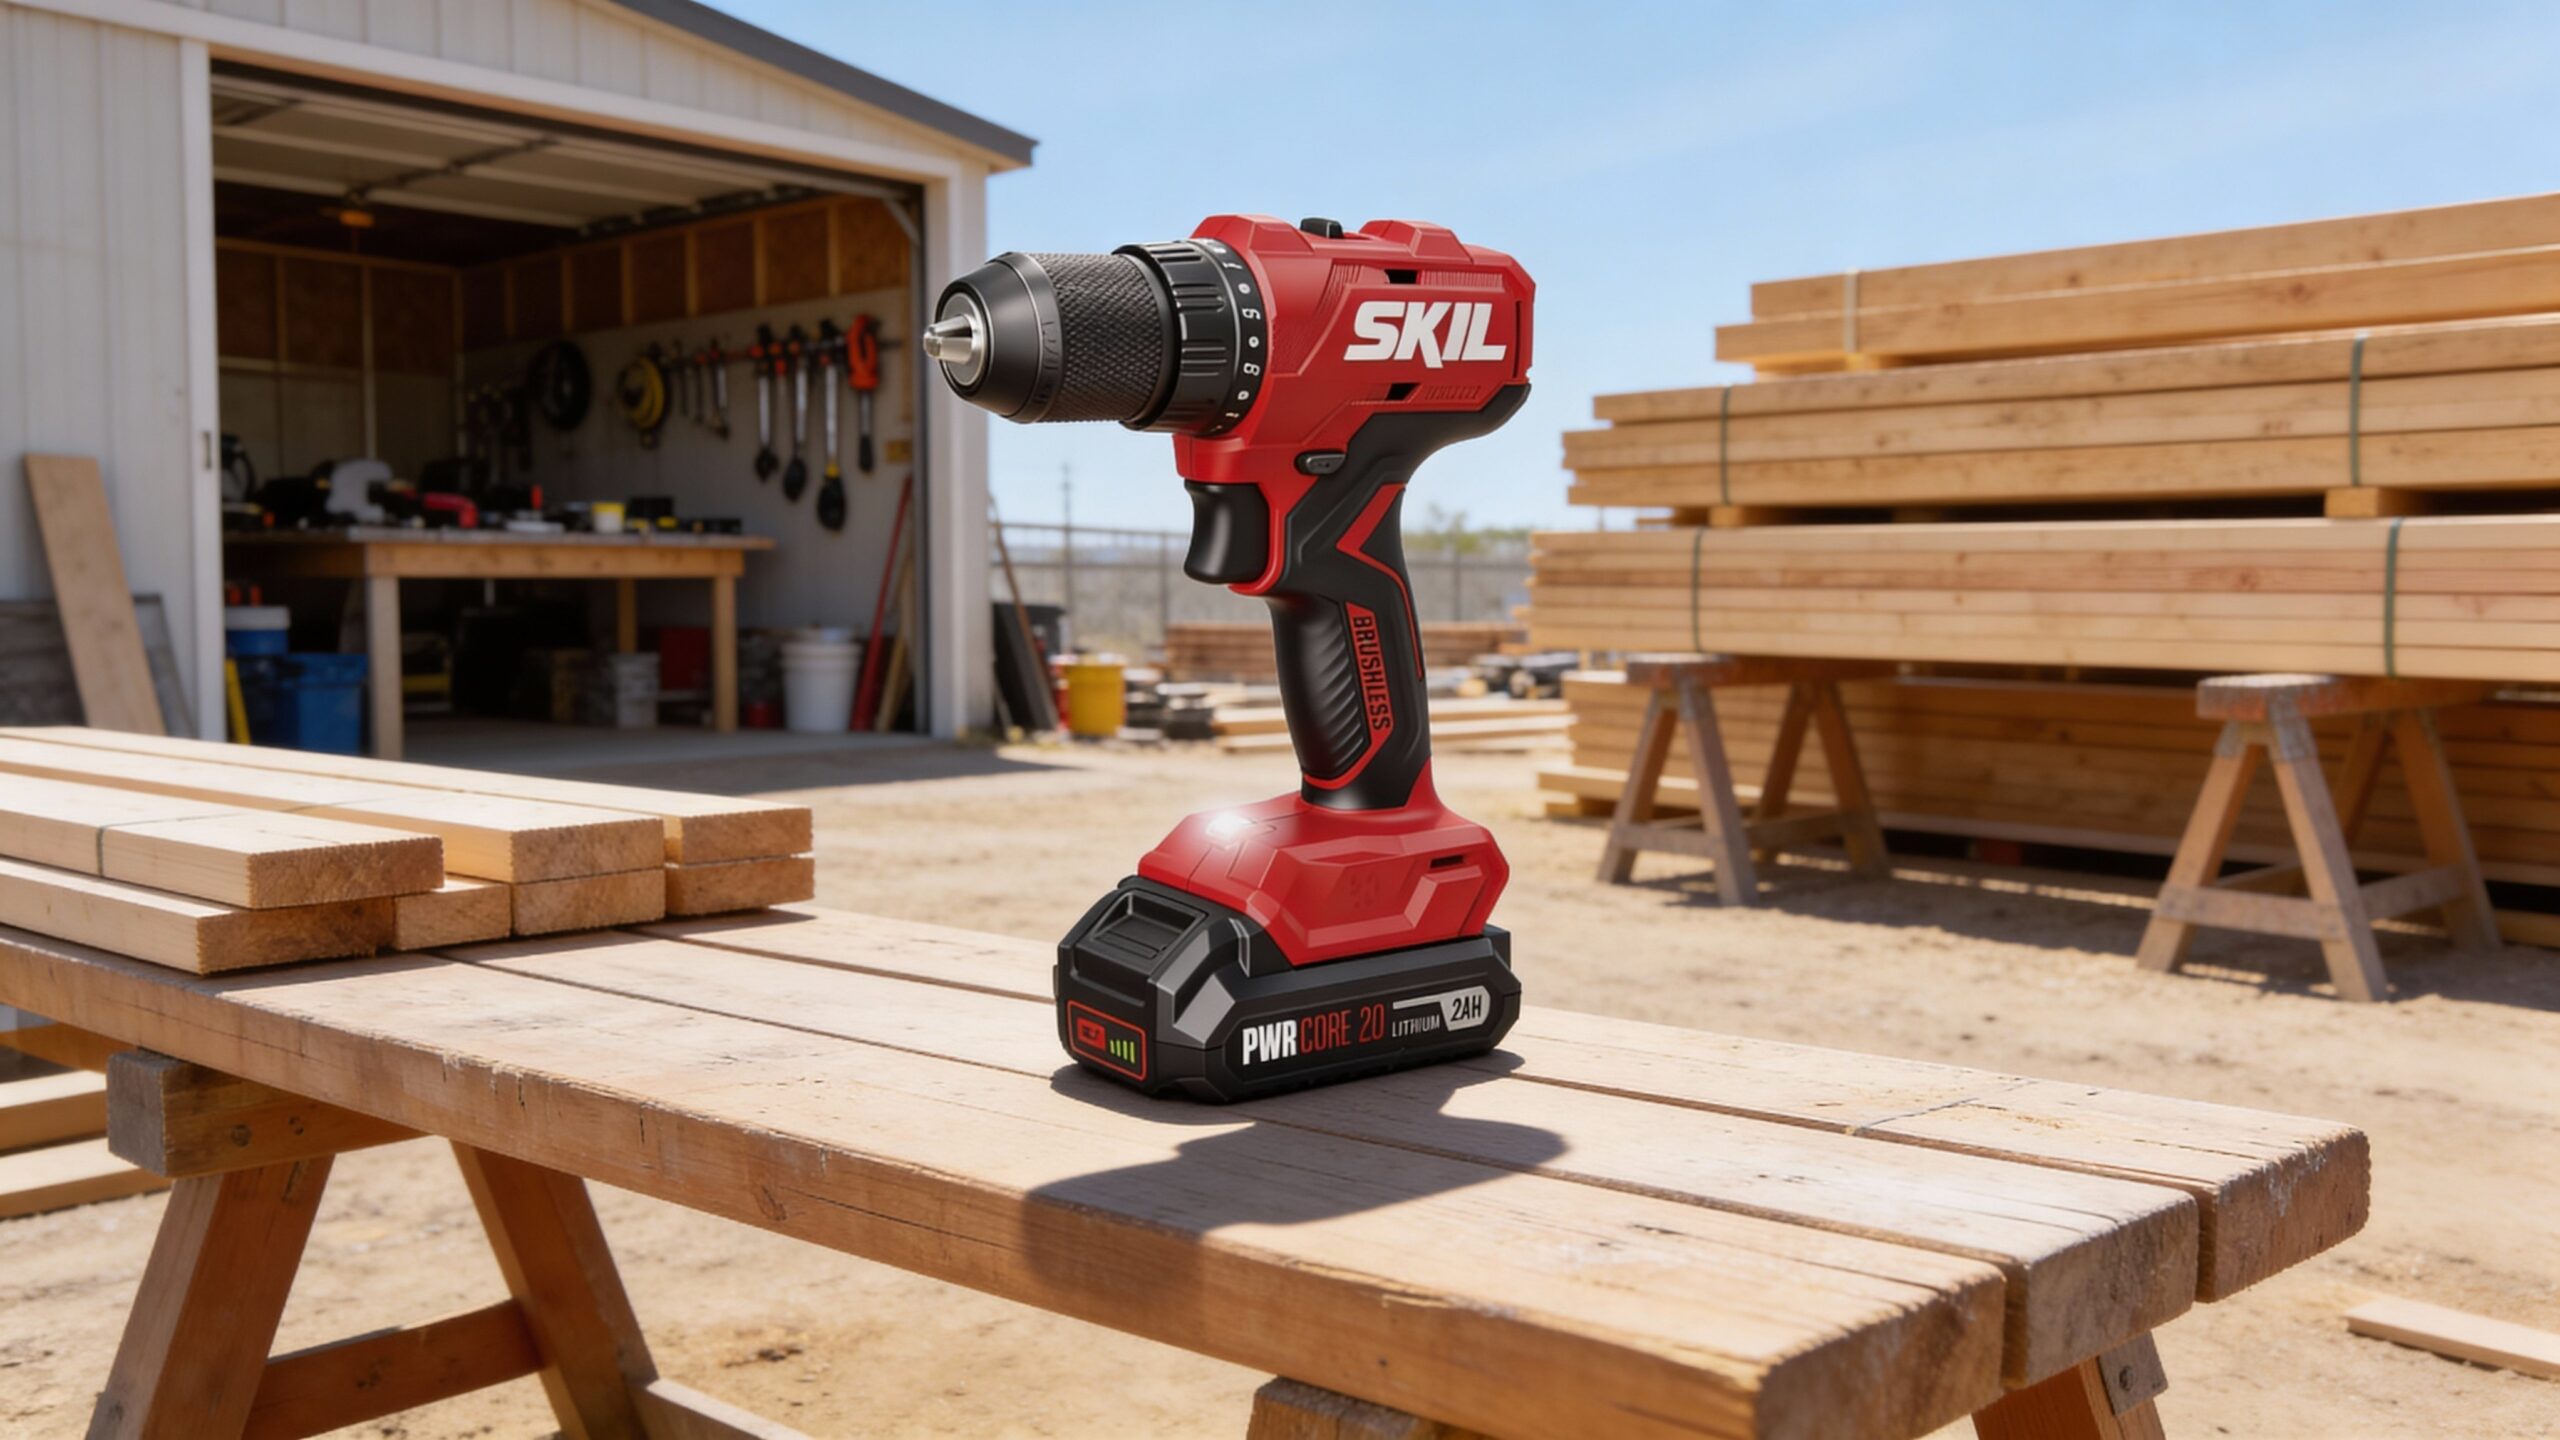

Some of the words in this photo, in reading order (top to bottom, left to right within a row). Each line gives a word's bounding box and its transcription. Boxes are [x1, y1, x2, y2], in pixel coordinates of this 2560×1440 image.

[1343, 301, 1507, 368] SKIL
[1353, 615, 1390, 731] BRUSHLESS
[1242, 1019, 1297, 1066] PWR
[1300, 1009, 1352, 1054] CORE
[1359, 1003, 1386, 1043] 20
[1391, 1015, 1441, 1038] LITHIUM
[1450, 994, 1483, 1022] 2AH
